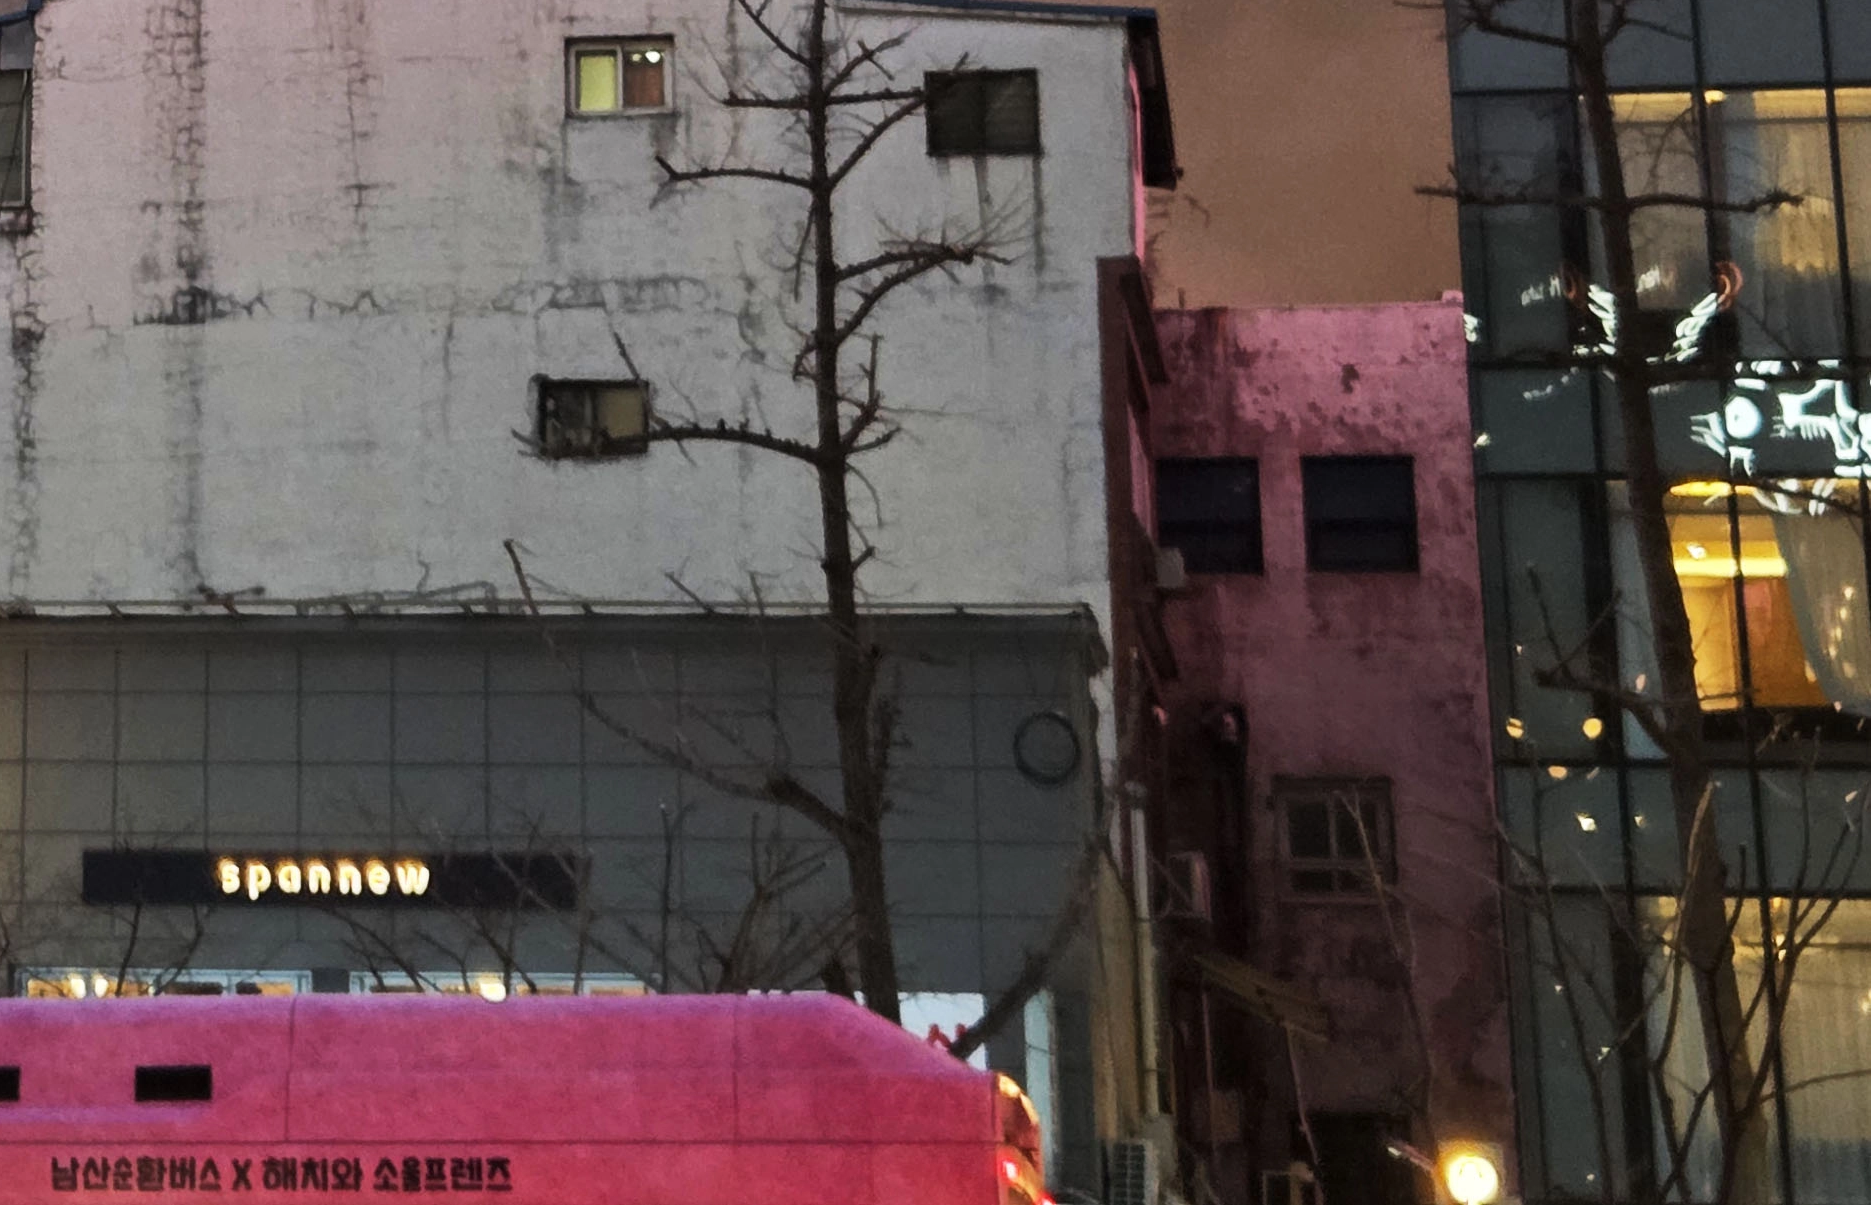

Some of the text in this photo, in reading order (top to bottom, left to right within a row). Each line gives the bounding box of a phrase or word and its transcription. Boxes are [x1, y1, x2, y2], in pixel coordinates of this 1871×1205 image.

[220, 859, 430, 901] spannew
[50, 1155, 514, 1192] 남산순환버스 X 해치와 소울프렌즈
